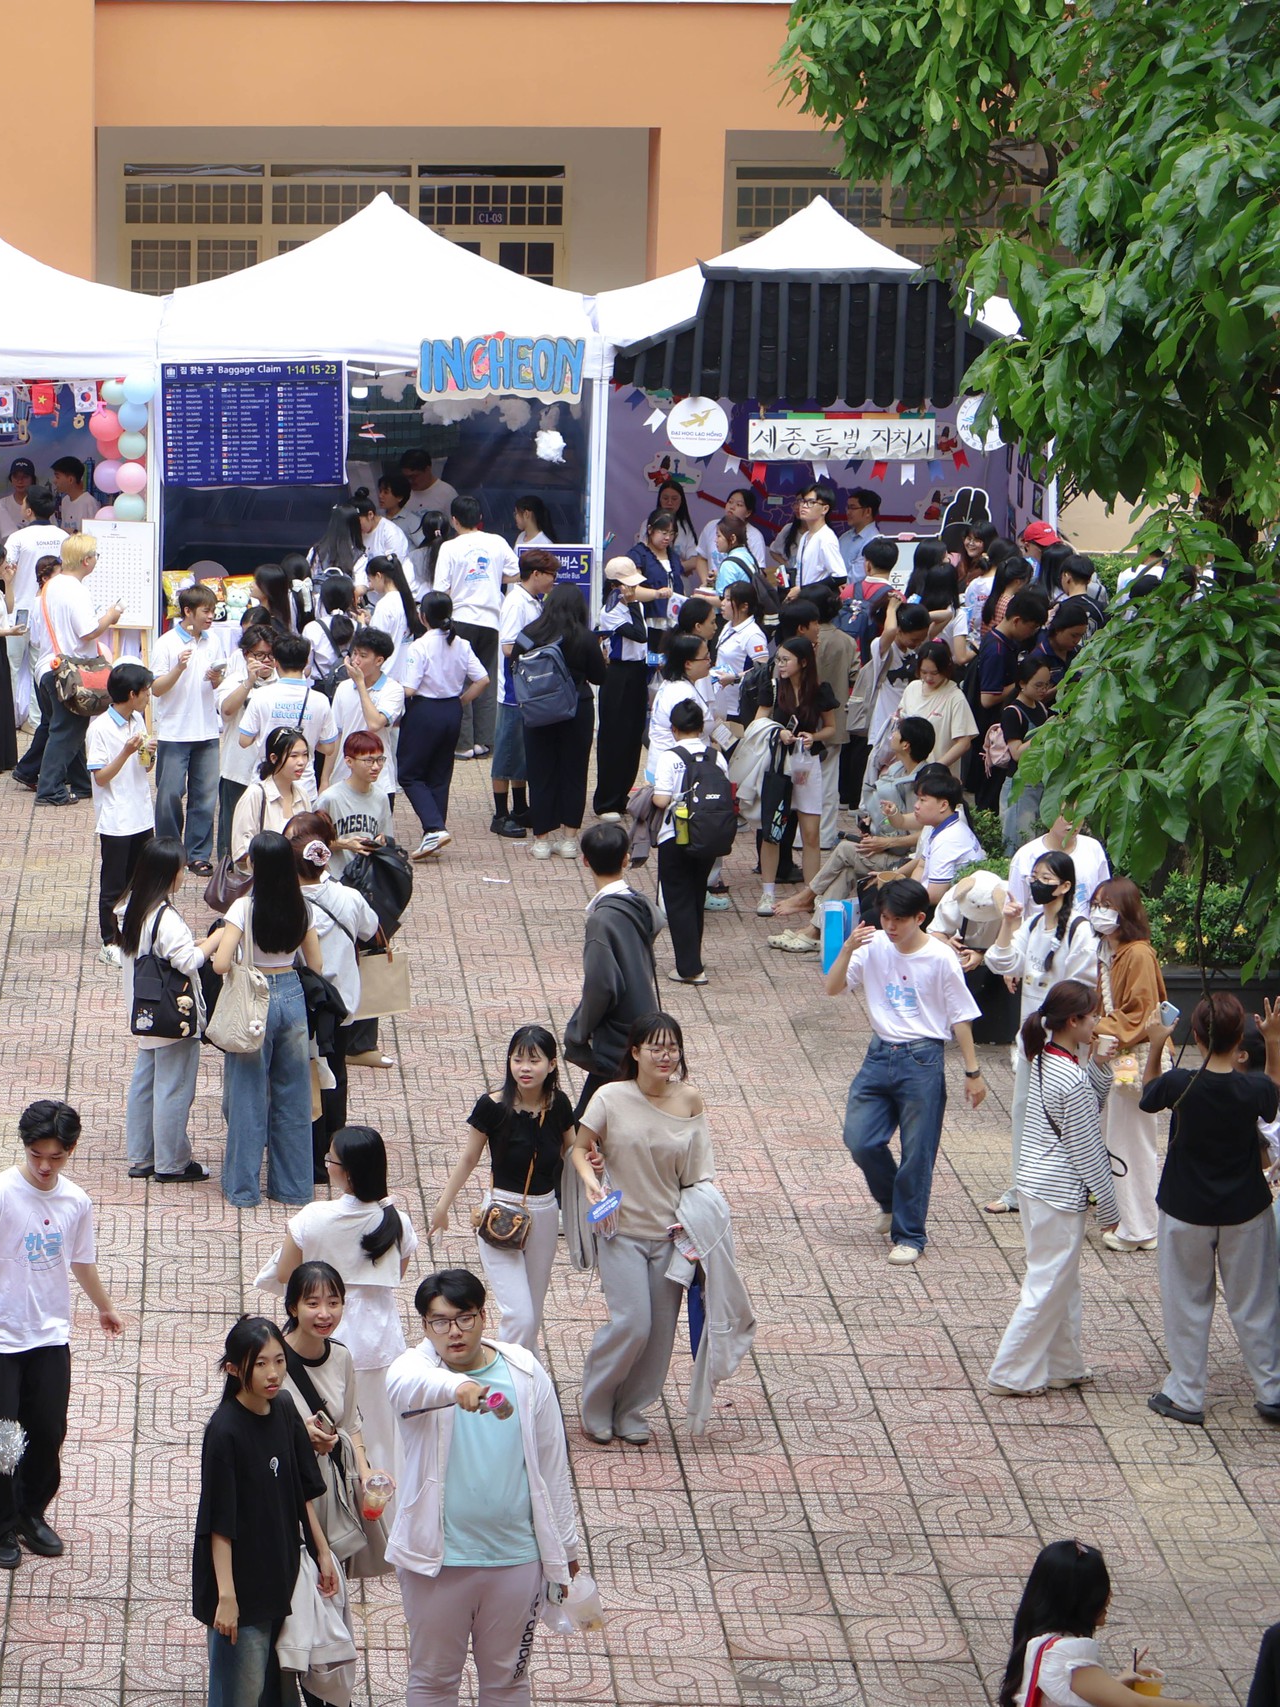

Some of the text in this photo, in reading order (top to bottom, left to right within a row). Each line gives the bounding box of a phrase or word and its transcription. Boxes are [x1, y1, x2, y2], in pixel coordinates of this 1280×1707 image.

[478, 213, 502, 223] C1-03
[180, 365, 336, 376] 짐 찾는 곳 Baggage Claim 1-14 15-23
[420, 338, 585, 394] INCHEON
[580, 554, 589, 574] 5
[272, 710, 313, 720] Educaton
[885, 983, 918, 1008] 한글
[24, 1233, 62, 1261] 한글
[514, 1619, 535, 1679] adidas
